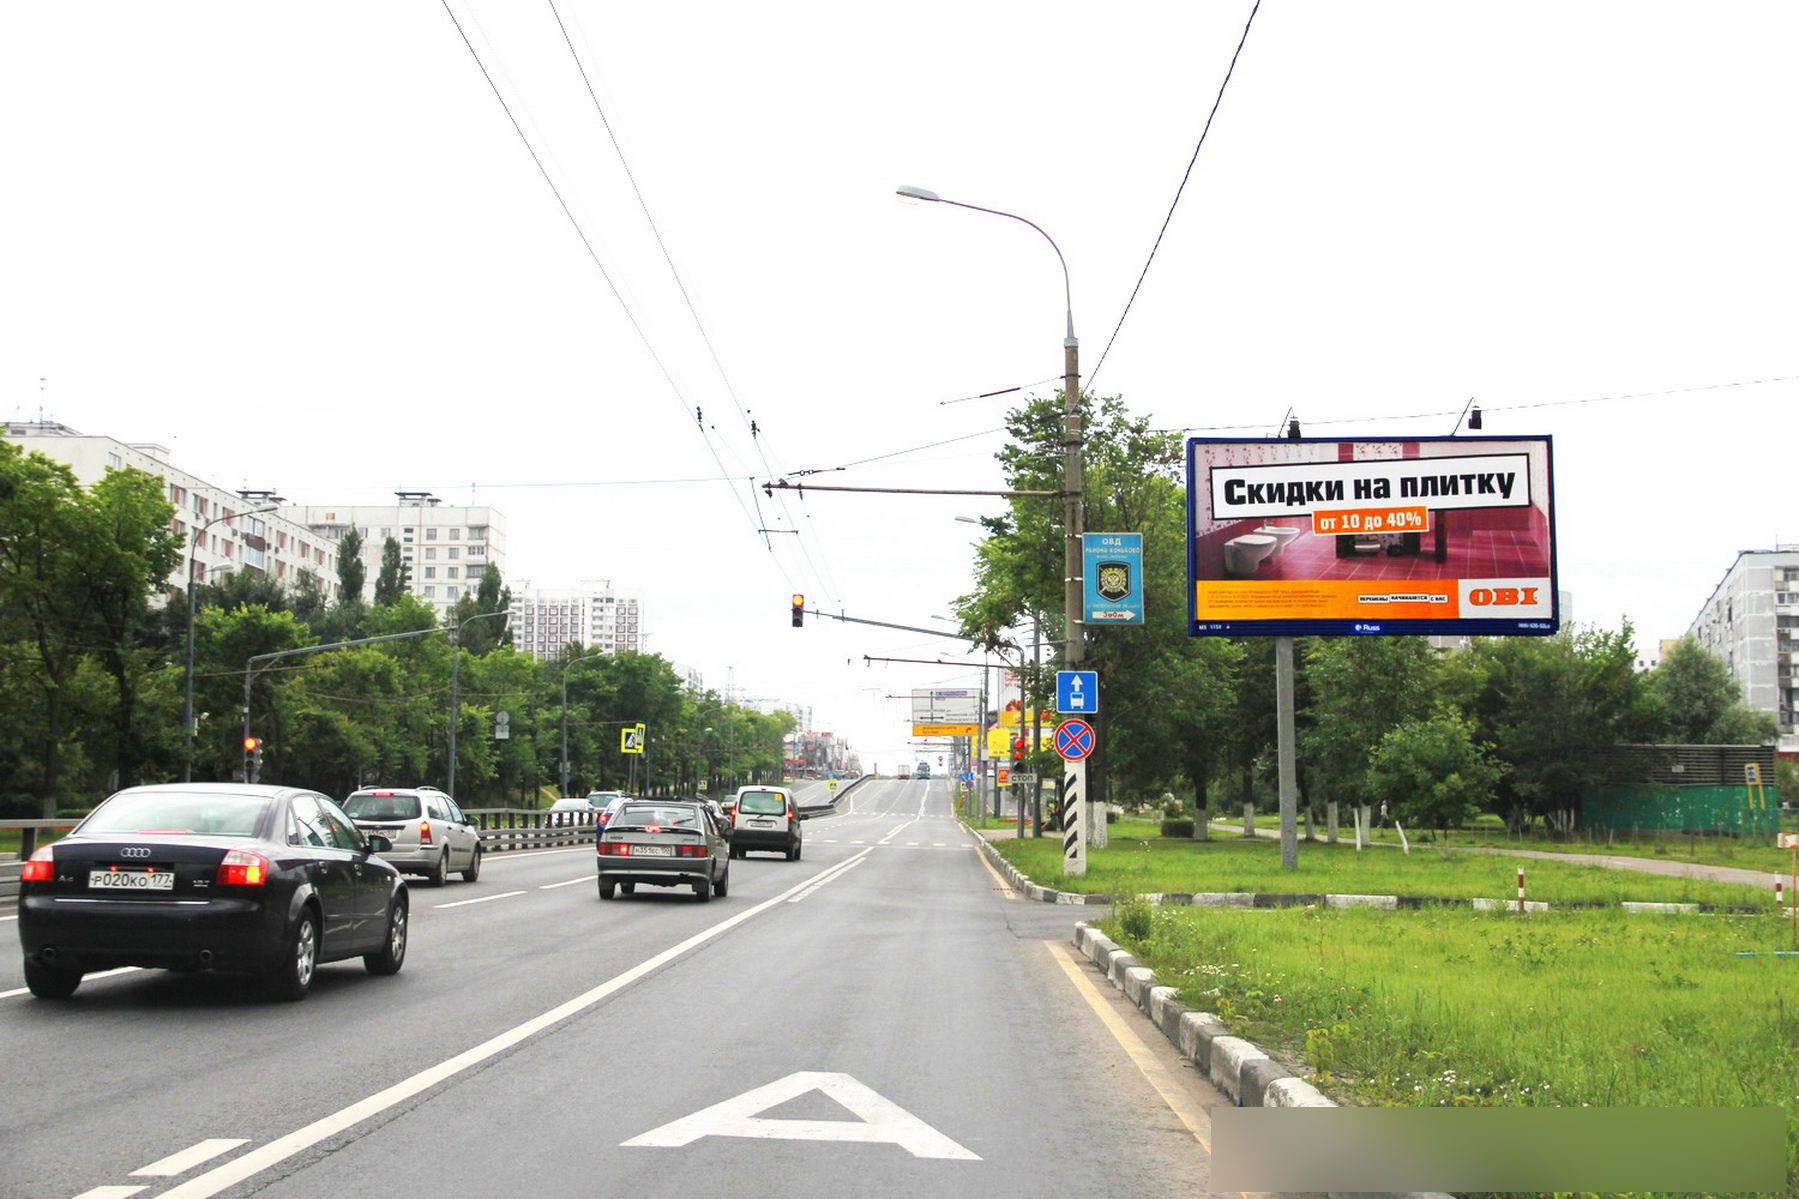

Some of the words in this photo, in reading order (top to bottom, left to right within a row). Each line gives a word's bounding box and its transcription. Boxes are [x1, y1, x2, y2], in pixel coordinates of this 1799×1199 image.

[1224, 478, 1344, 507] Скидки
[1353, 477, 1391, 500] на
[1400, 472, 1516, 499] плитку
[1320, 517, 1337, 530] от
[1341, 514, 1360, 529] 10
[1364, 516, 1383, 530] до
[1386, 511, 1422, 527] 40%
[1469, 587, 1538, 606] OBI
